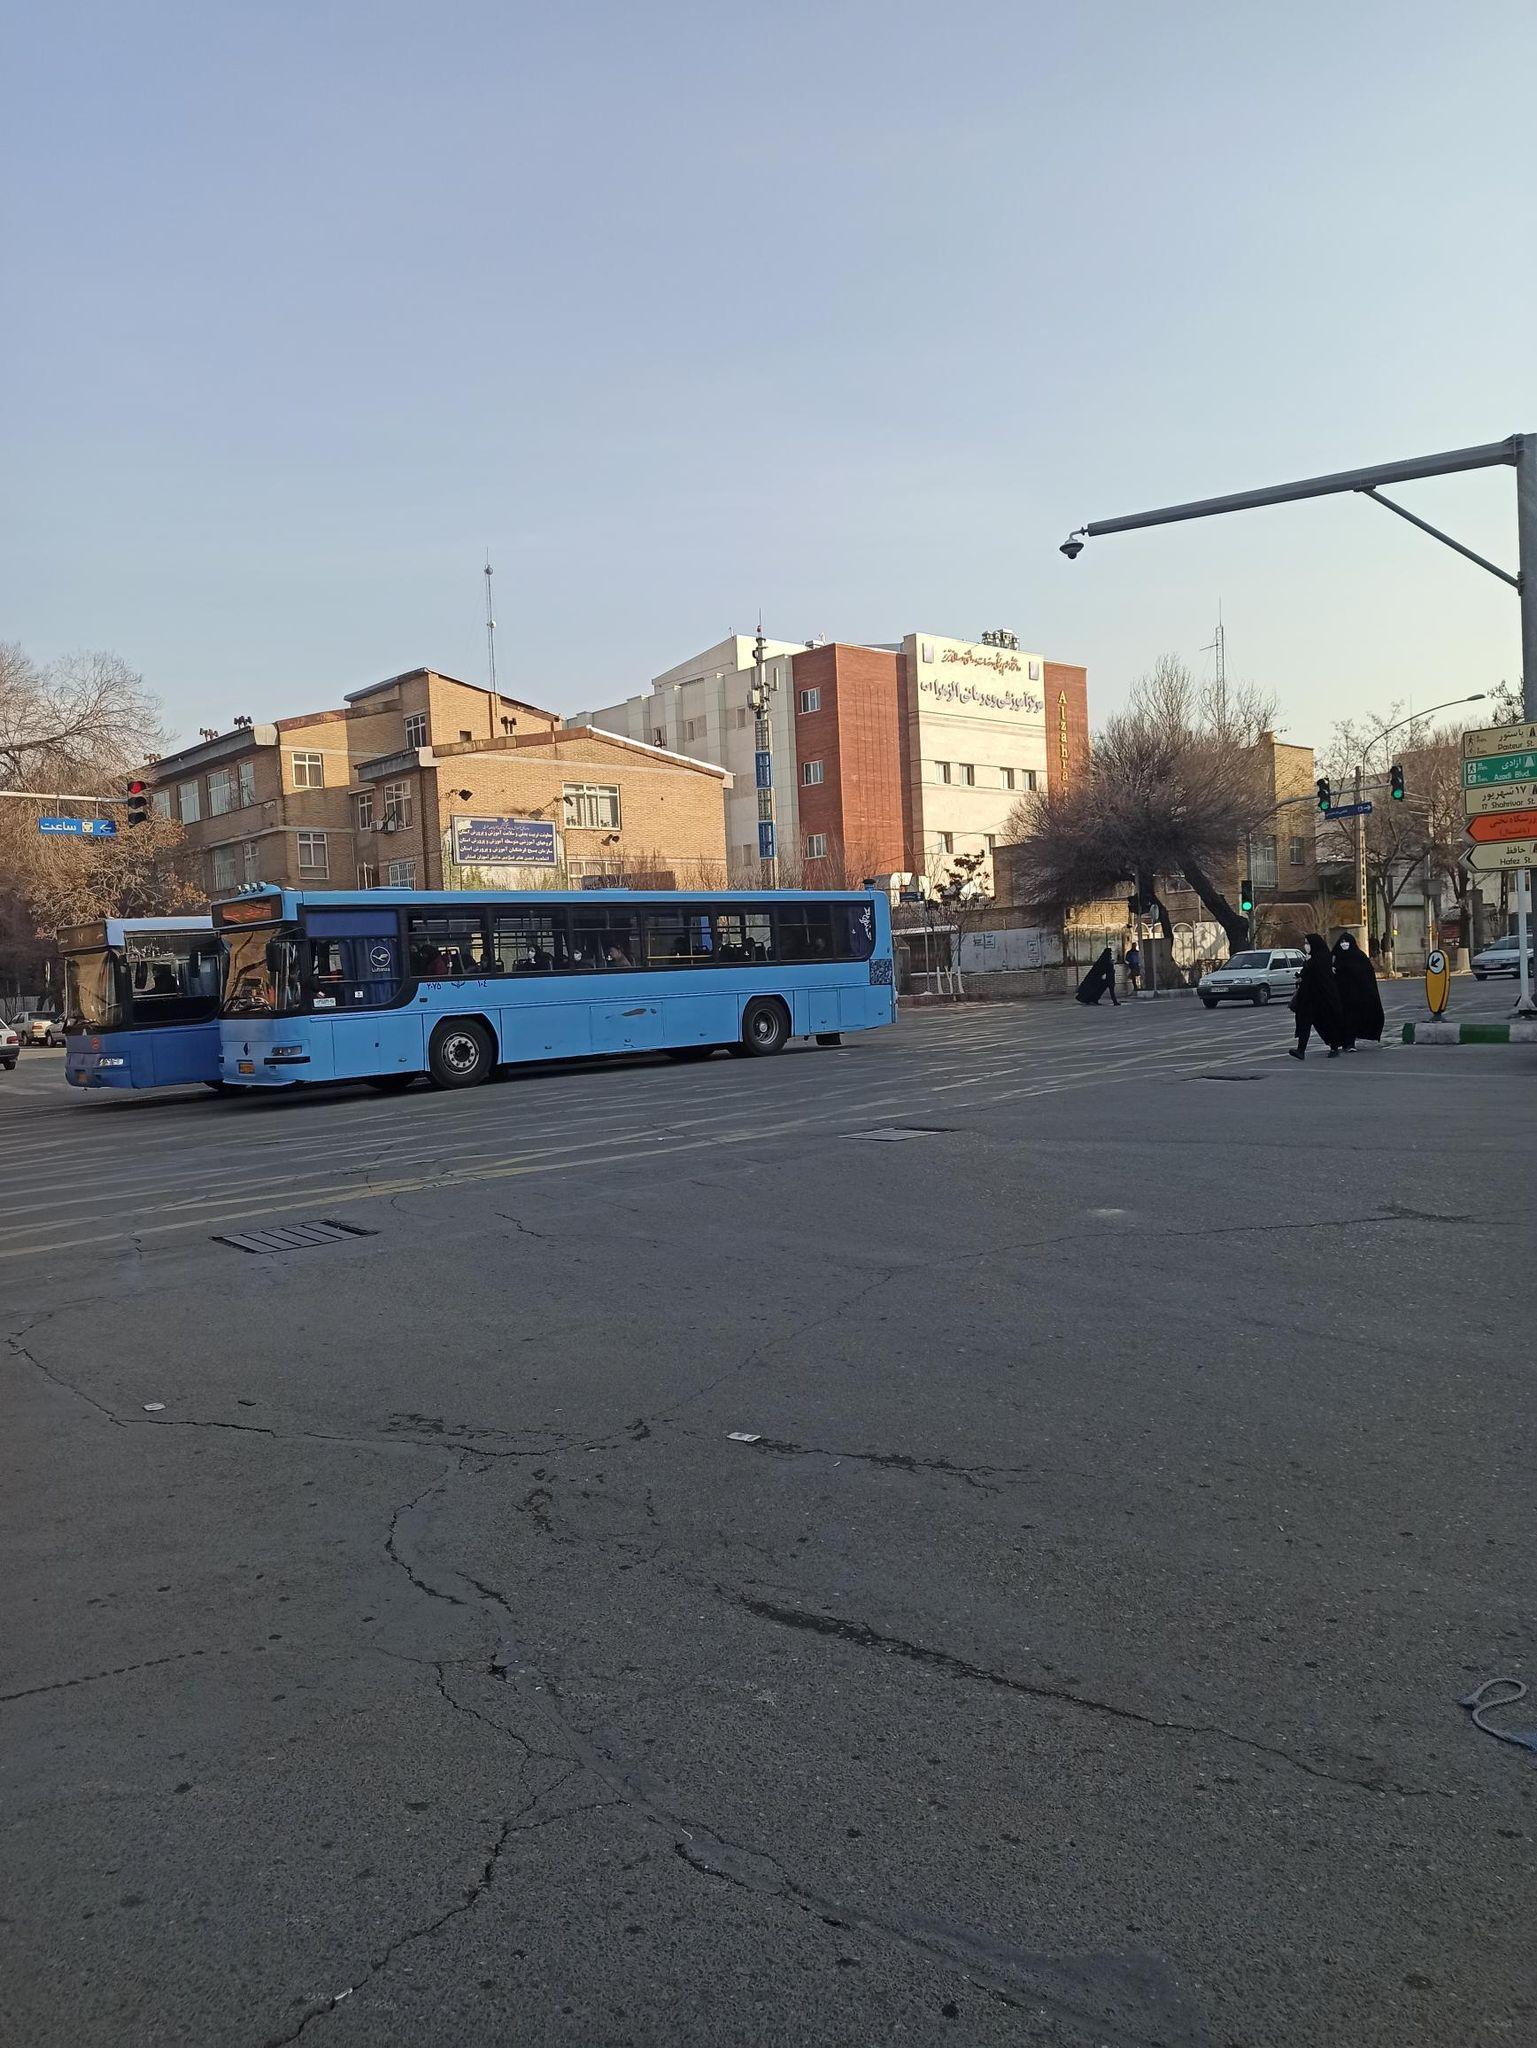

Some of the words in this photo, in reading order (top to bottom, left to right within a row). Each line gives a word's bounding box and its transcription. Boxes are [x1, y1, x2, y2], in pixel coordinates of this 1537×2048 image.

[1059, 690, 1069, 781] Alzahra
[1494, 772, 1512, 781] Azadi
[1482, 786, 1515, 801] شهریور
[1491, 800, 1523, 809] Shahrivar
[40, 821, 77, 831] ساعت
[1506, 846, 1526, 855] حافظ
